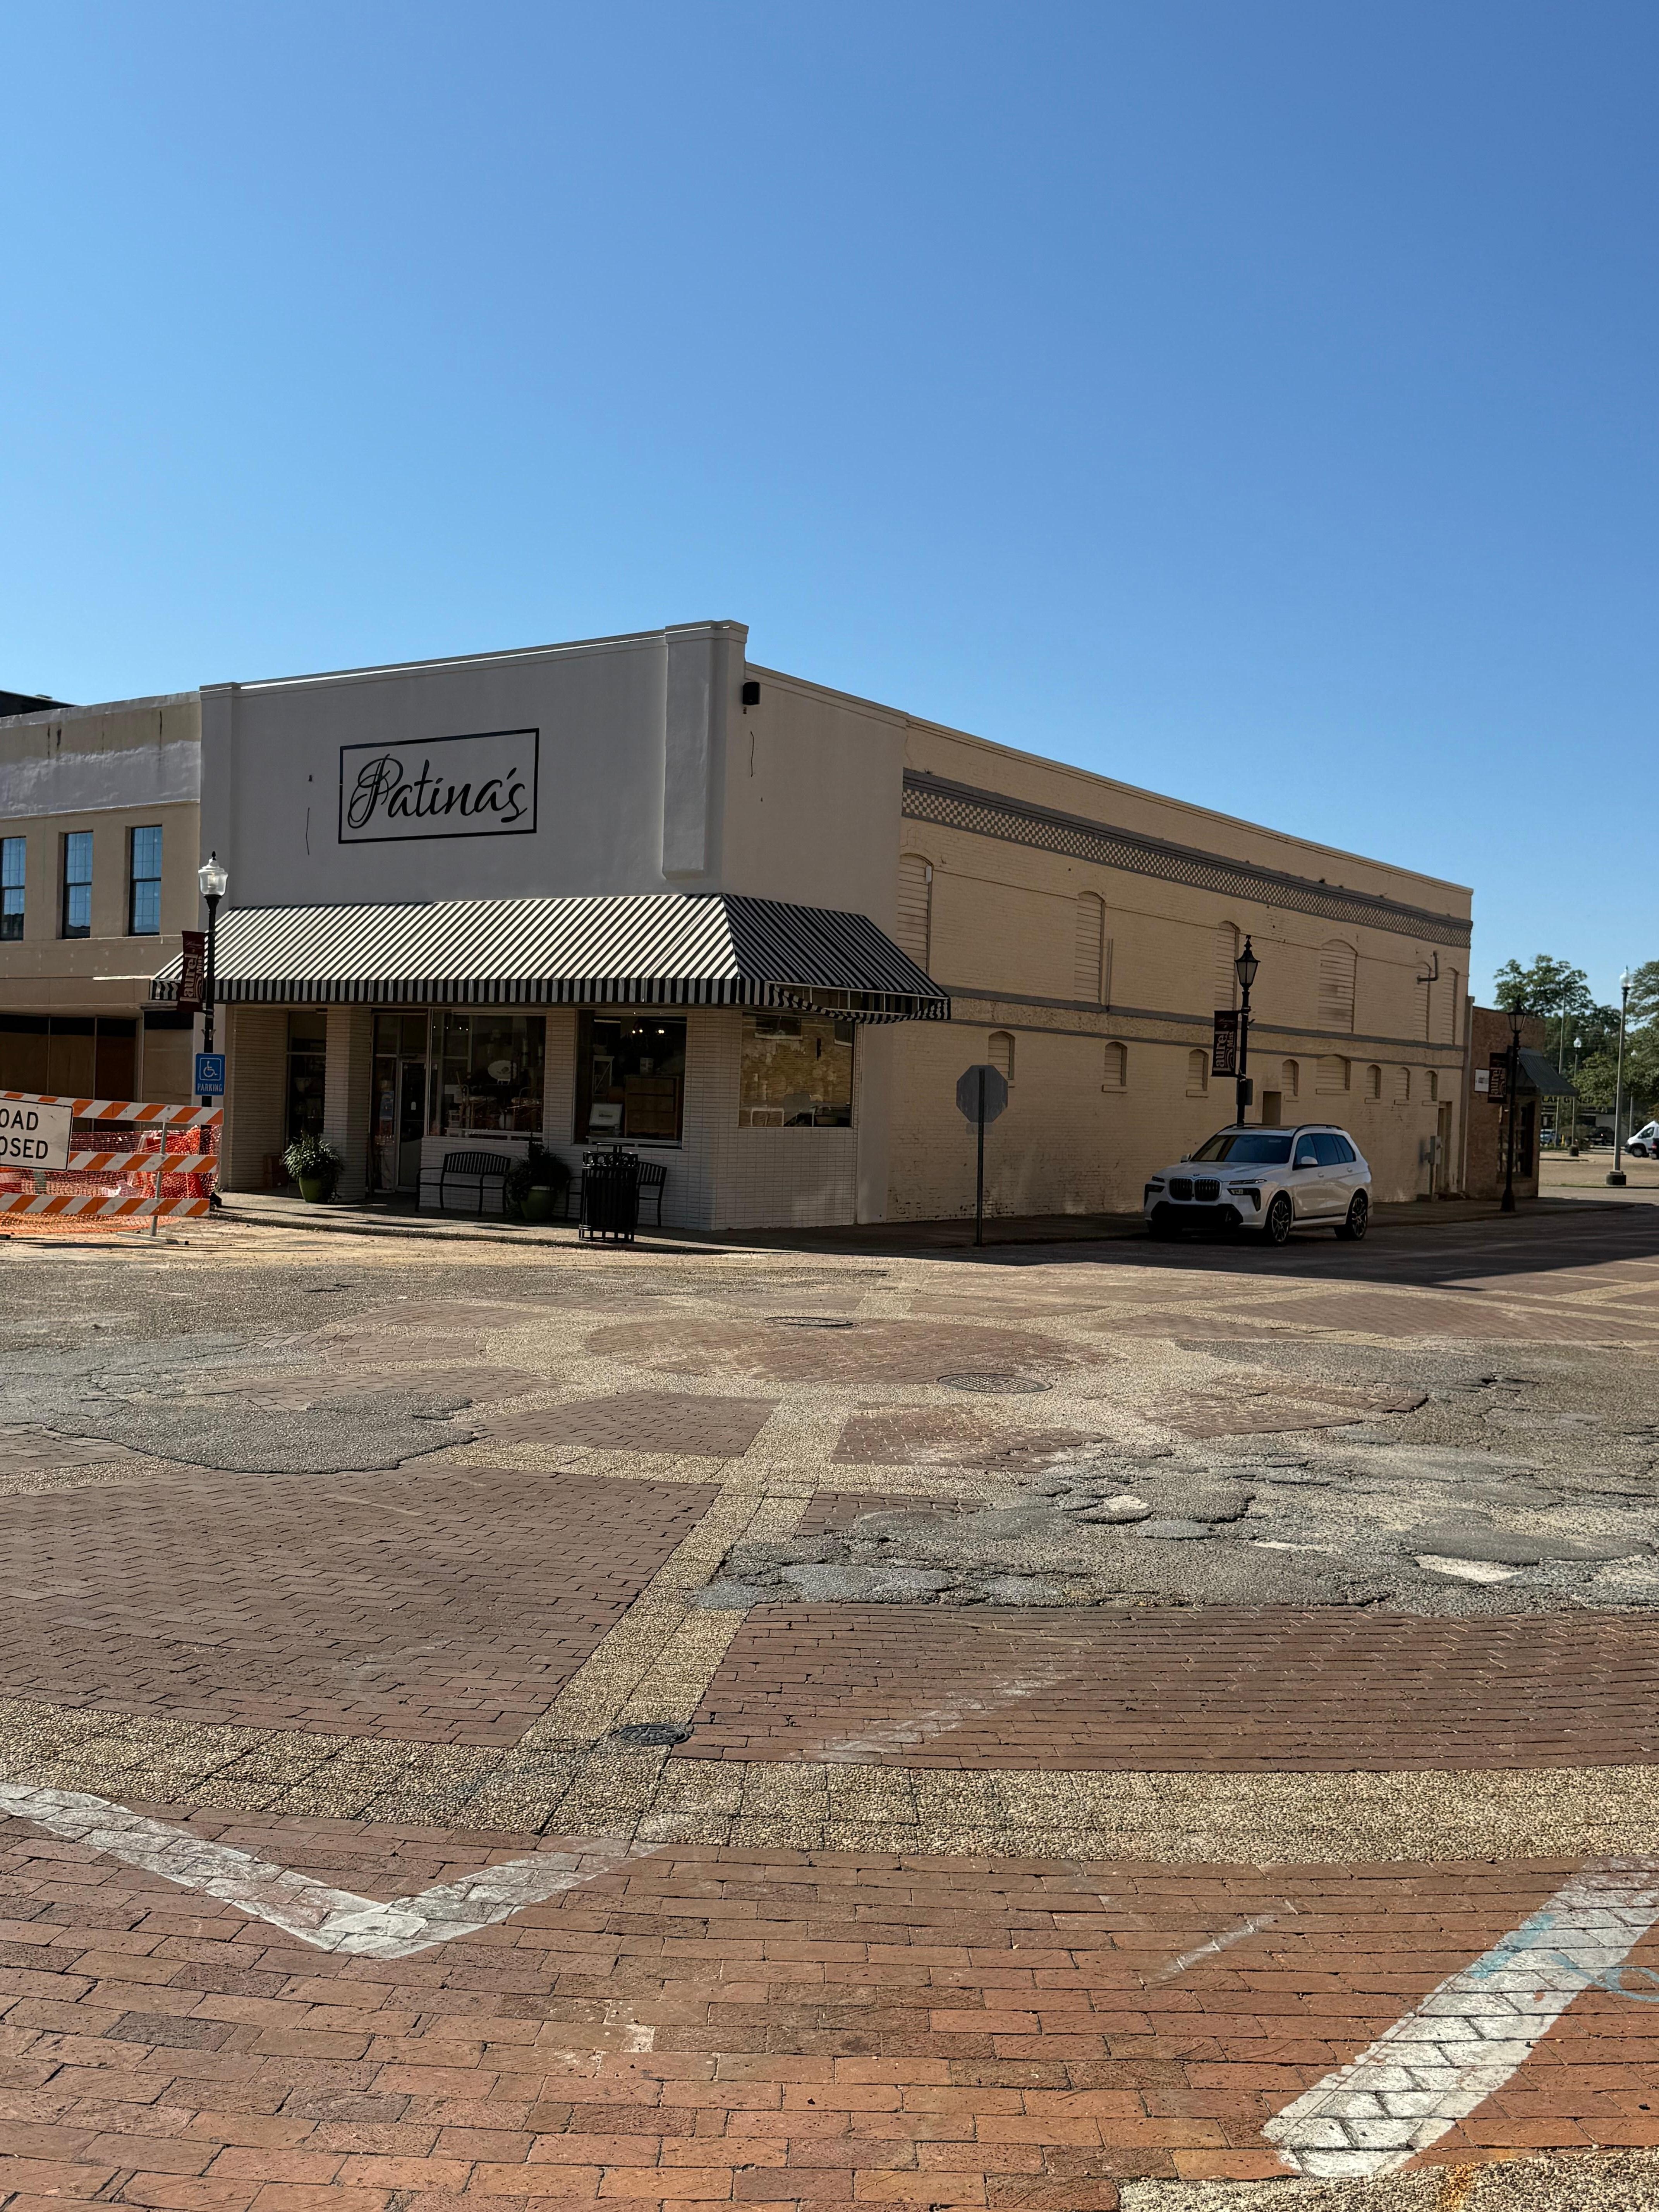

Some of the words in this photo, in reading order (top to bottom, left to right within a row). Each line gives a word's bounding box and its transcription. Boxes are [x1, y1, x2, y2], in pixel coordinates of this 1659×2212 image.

[348, 753, 527, 828] Patina's
[198, 1083, 222, 1092] PARKING
[0, 1108, 39, 1130] OAD
[0, 1136, 48, 1159] OSED
